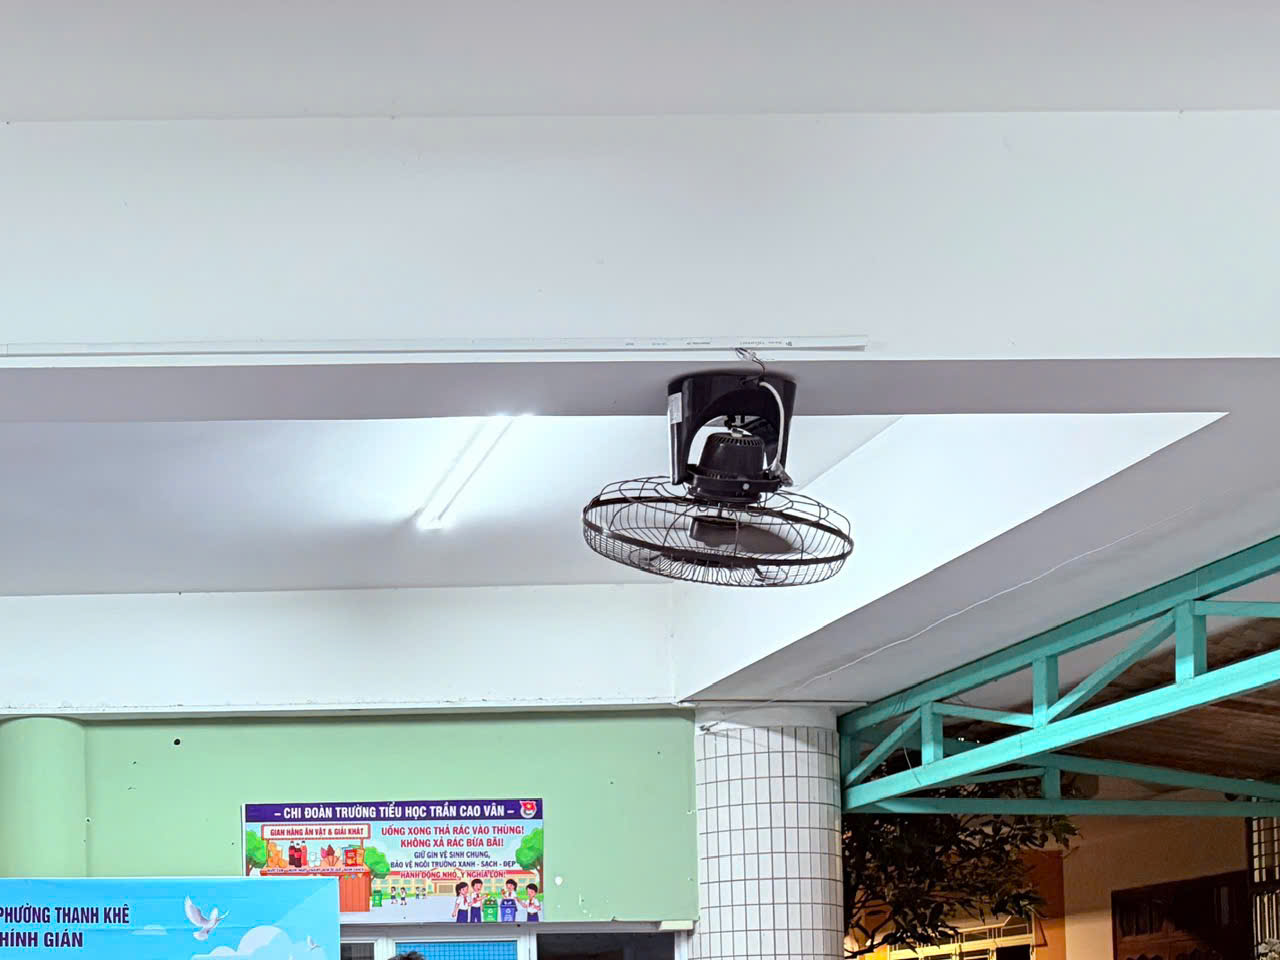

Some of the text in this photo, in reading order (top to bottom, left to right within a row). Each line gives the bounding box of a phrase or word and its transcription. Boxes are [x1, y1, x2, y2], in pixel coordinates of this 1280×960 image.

[283, 807, 301, 819] CHI
[304, 804, 332, 818] ĐOÀN
[335, 804, 376, 818] TRƯỜNG
[379, 801, 402, 817] TIỂU
[405, 806, 426, 820] HỌC
[429, 802, 456, 817] TRẦN
[460, 805, 481, 817] CAO
[483, 802, 505, 816] VÂN
[381, 823, 524, 836] UỐNG XONG THẢ RÁC VÀO THÙNG!
[401, 837, 431, 848] KHÔNG
[447, 836, 464, 847] RÁC
[449, 851, 465, 859] SINH
[55, 907, 99, 924] THANH
[103, 904, 129, 924] KHÊ
[44, 928, 83, 948] GIÁN
